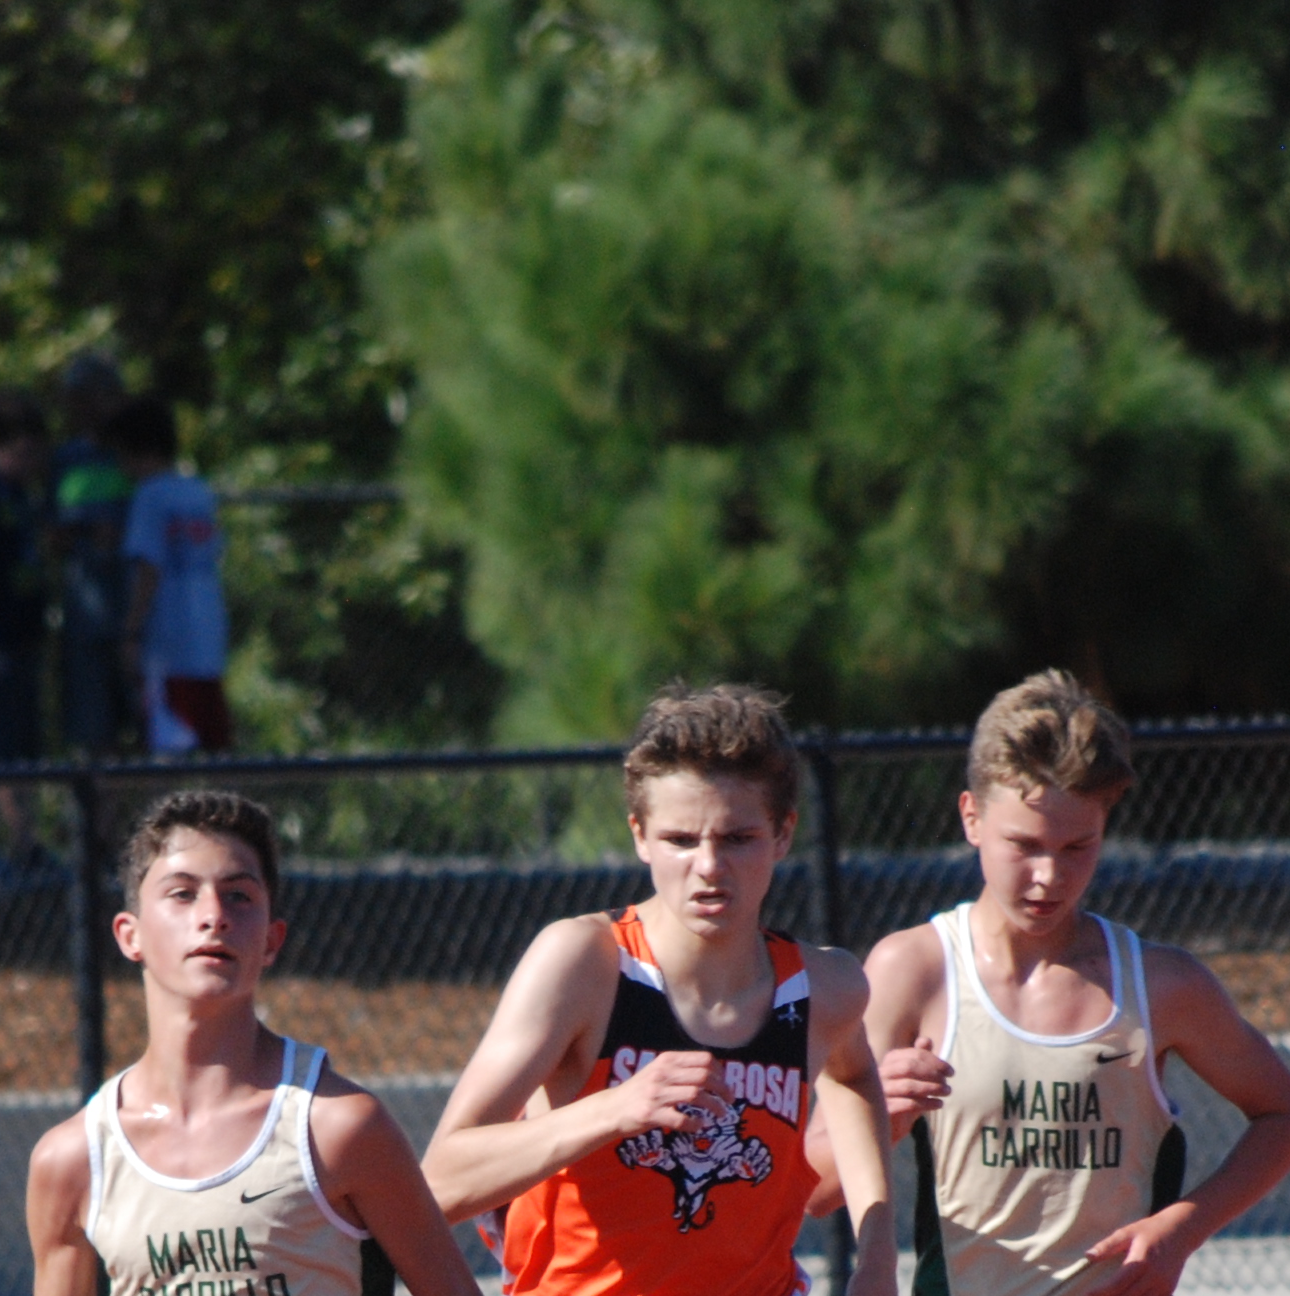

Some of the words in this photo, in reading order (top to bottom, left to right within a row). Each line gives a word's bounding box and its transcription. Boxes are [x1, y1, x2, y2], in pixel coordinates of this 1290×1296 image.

[723, 1059, 802, 1127] ROSA
[1002, 1078, 1102, 1123] MARIA
[981, 1125, 1123, 1170] CARRILLO
[145, 1226, 257, 1279] MARIA
